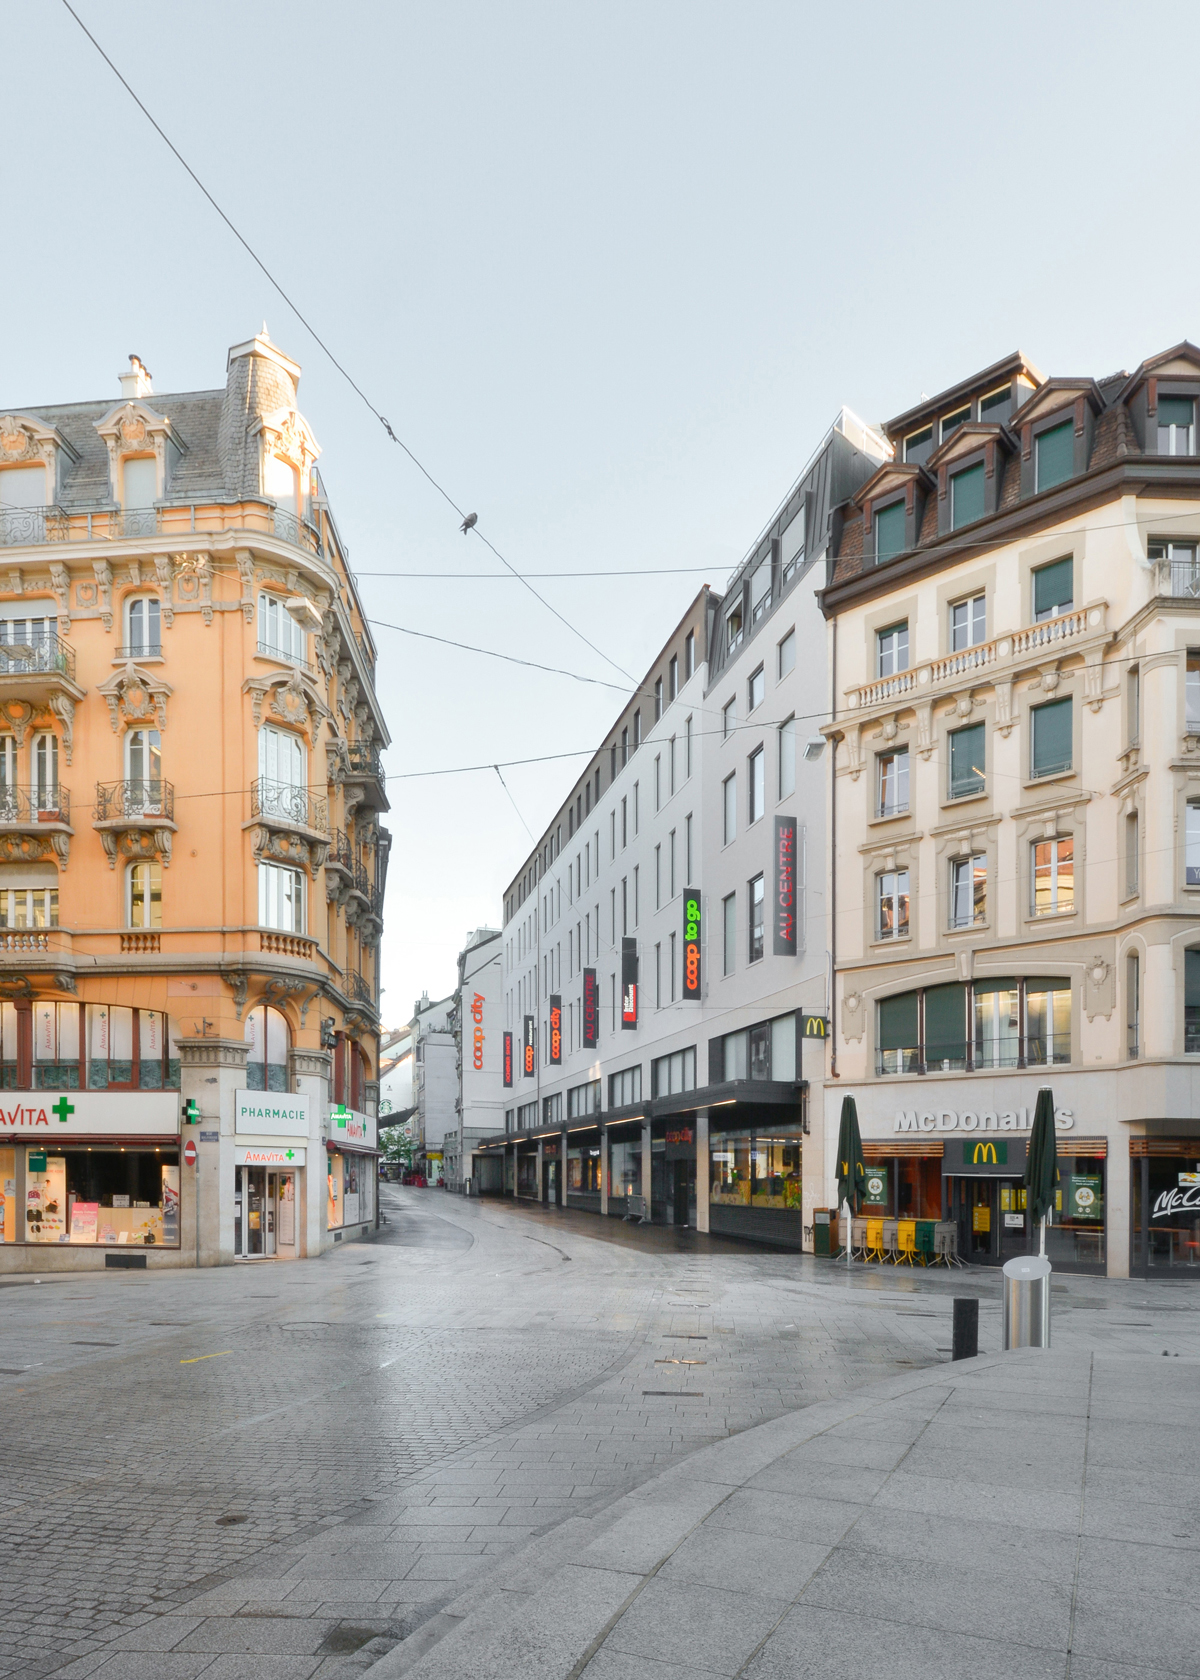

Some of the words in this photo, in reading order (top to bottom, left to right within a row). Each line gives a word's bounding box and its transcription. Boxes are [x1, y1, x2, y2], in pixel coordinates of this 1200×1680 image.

[779, 826, 793, 907] CENTRE
[686, 899, 701, 921] go
[685, 922, 698, 941] to
[779, 912, 793, 941] AU
[686, 943, 700, 990] coop
[471, 992, 486, 1024] city
[586, 974, 595, 1021] CENTRE
[550, 1007, 561, 1029] city
[586, 1023, 595, 1040] AU
[473, 1026, 486, 1070] coop
[525, 1045, 534, 1072] coop
[551, 1029, 561, 1059] coop
[241, 1107, 305, 1120] PHARMACIE
